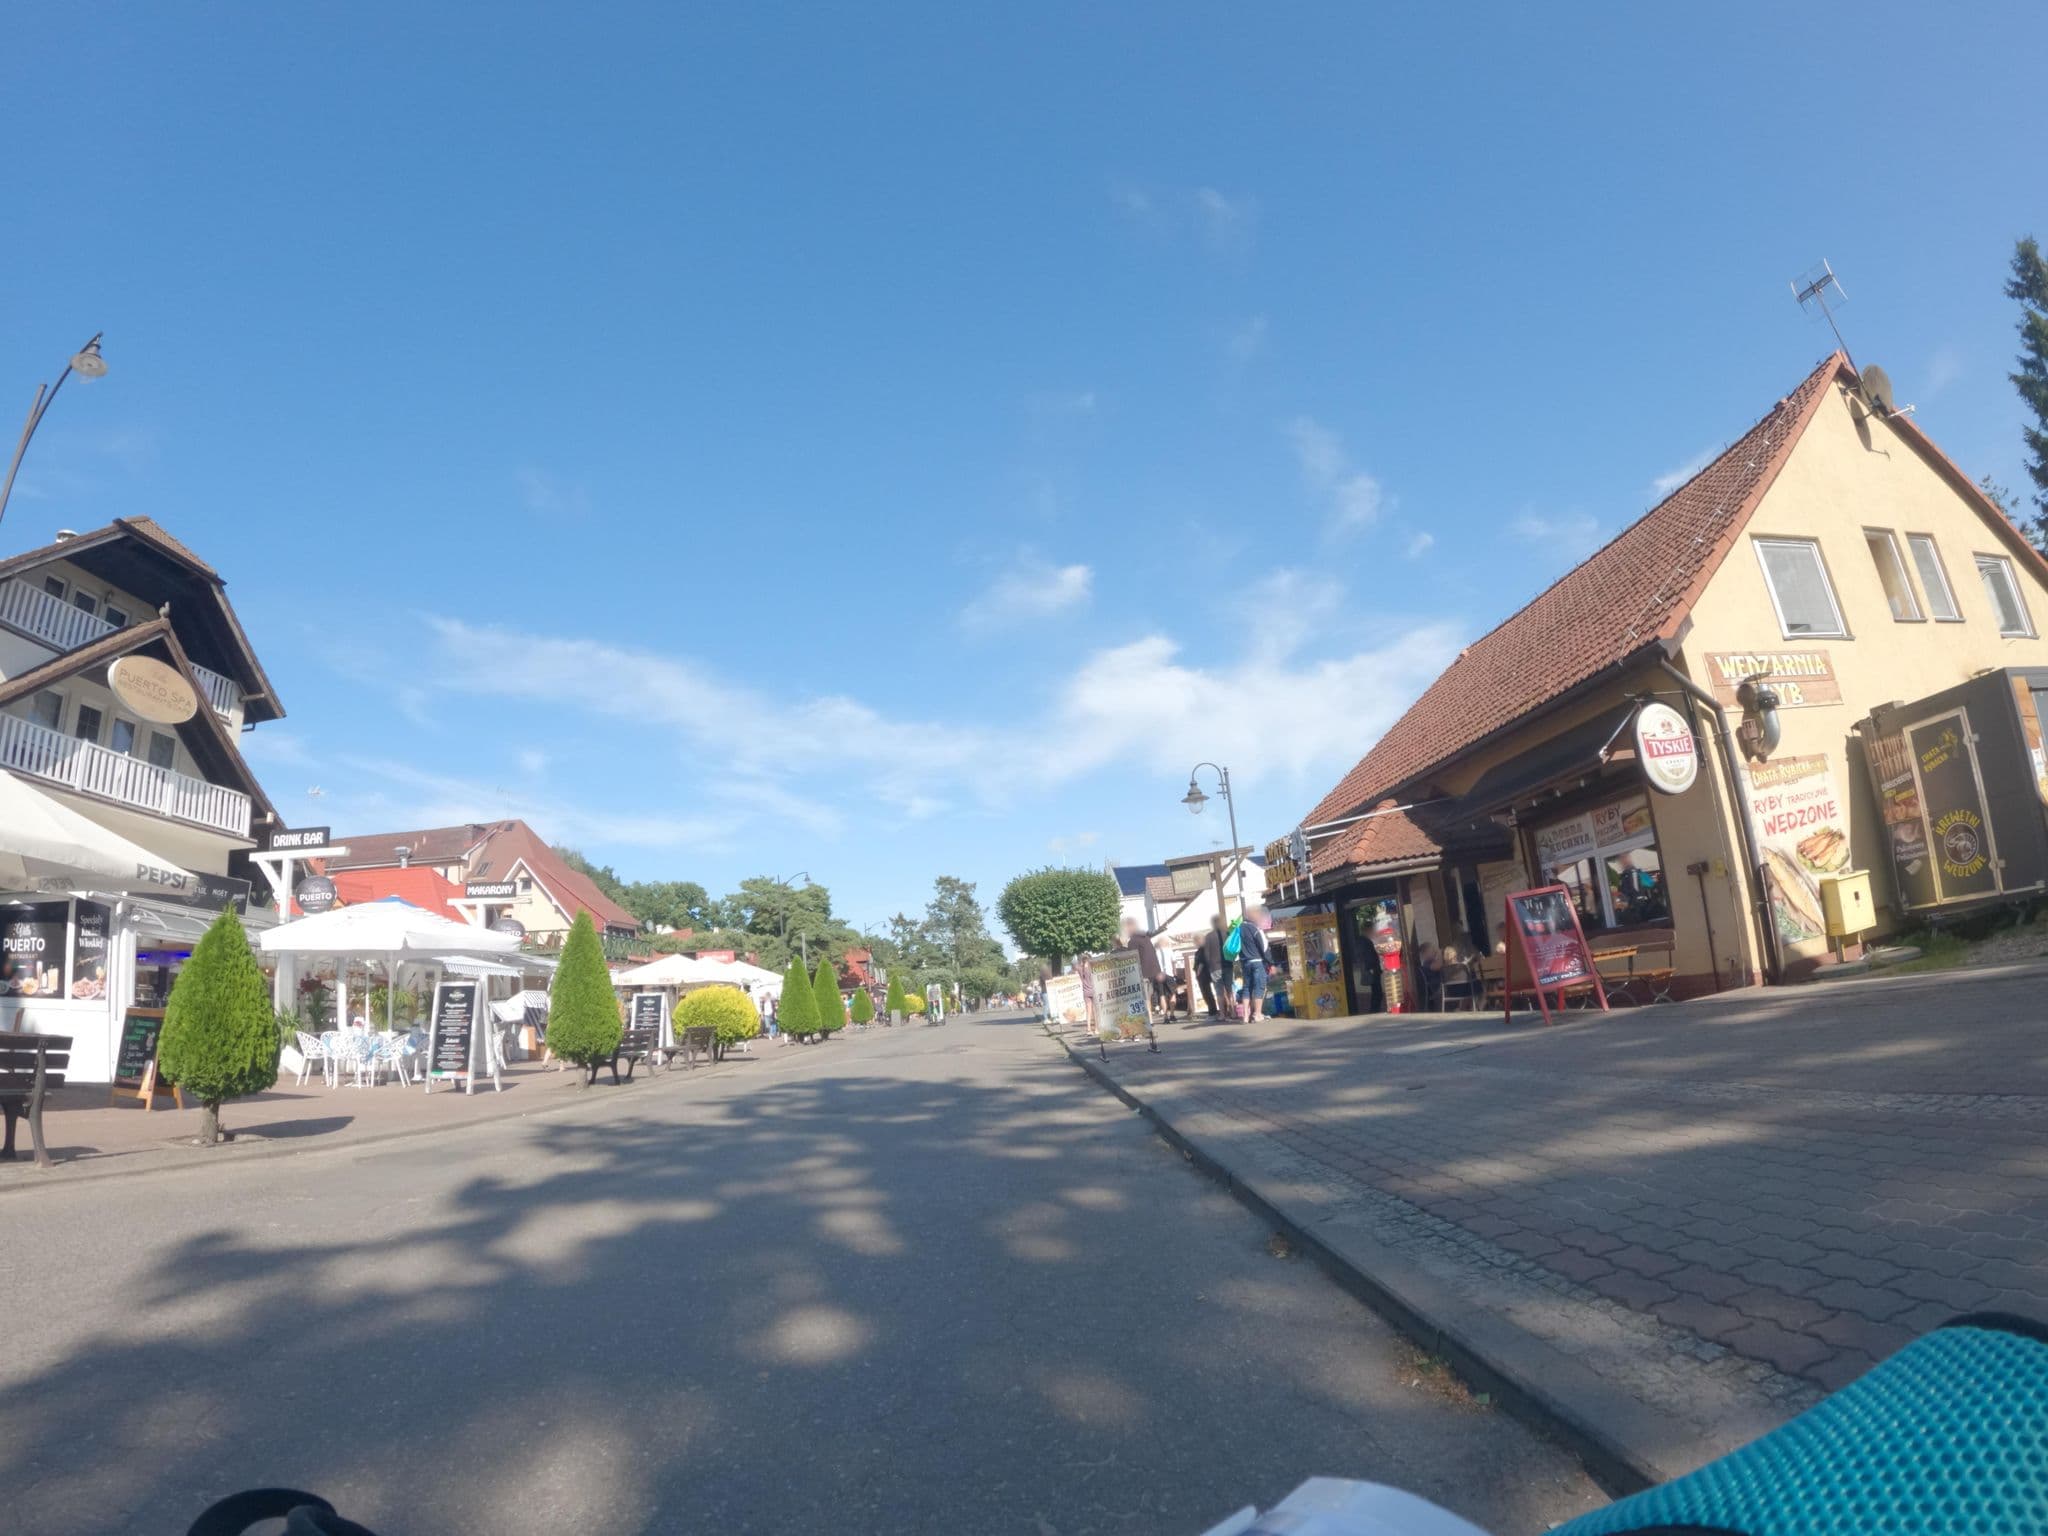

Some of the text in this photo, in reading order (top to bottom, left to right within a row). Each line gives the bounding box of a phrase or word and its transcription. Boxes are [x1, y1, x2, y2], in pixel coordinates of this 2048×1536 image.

[119, 668, 168, 697] PUERTO
[1648, 737, 1692, 756] TYSKIE
[1754, 794, 1783, 814] RYBY
[1596, 806, 1621, 825] RYBY
[1763, 801, 1838, 836] WĘDZONE
[273, 832, 324, 847] DRINK BAR
[136, 863, 187, 889] PEPSI
[299, 893, 332, 902] PUERTO
[467, 885, 513, 895] MAKARONY
[3, 938, 45, 952] PUERTO
[1129, 1002, 1140, 1015] 39
